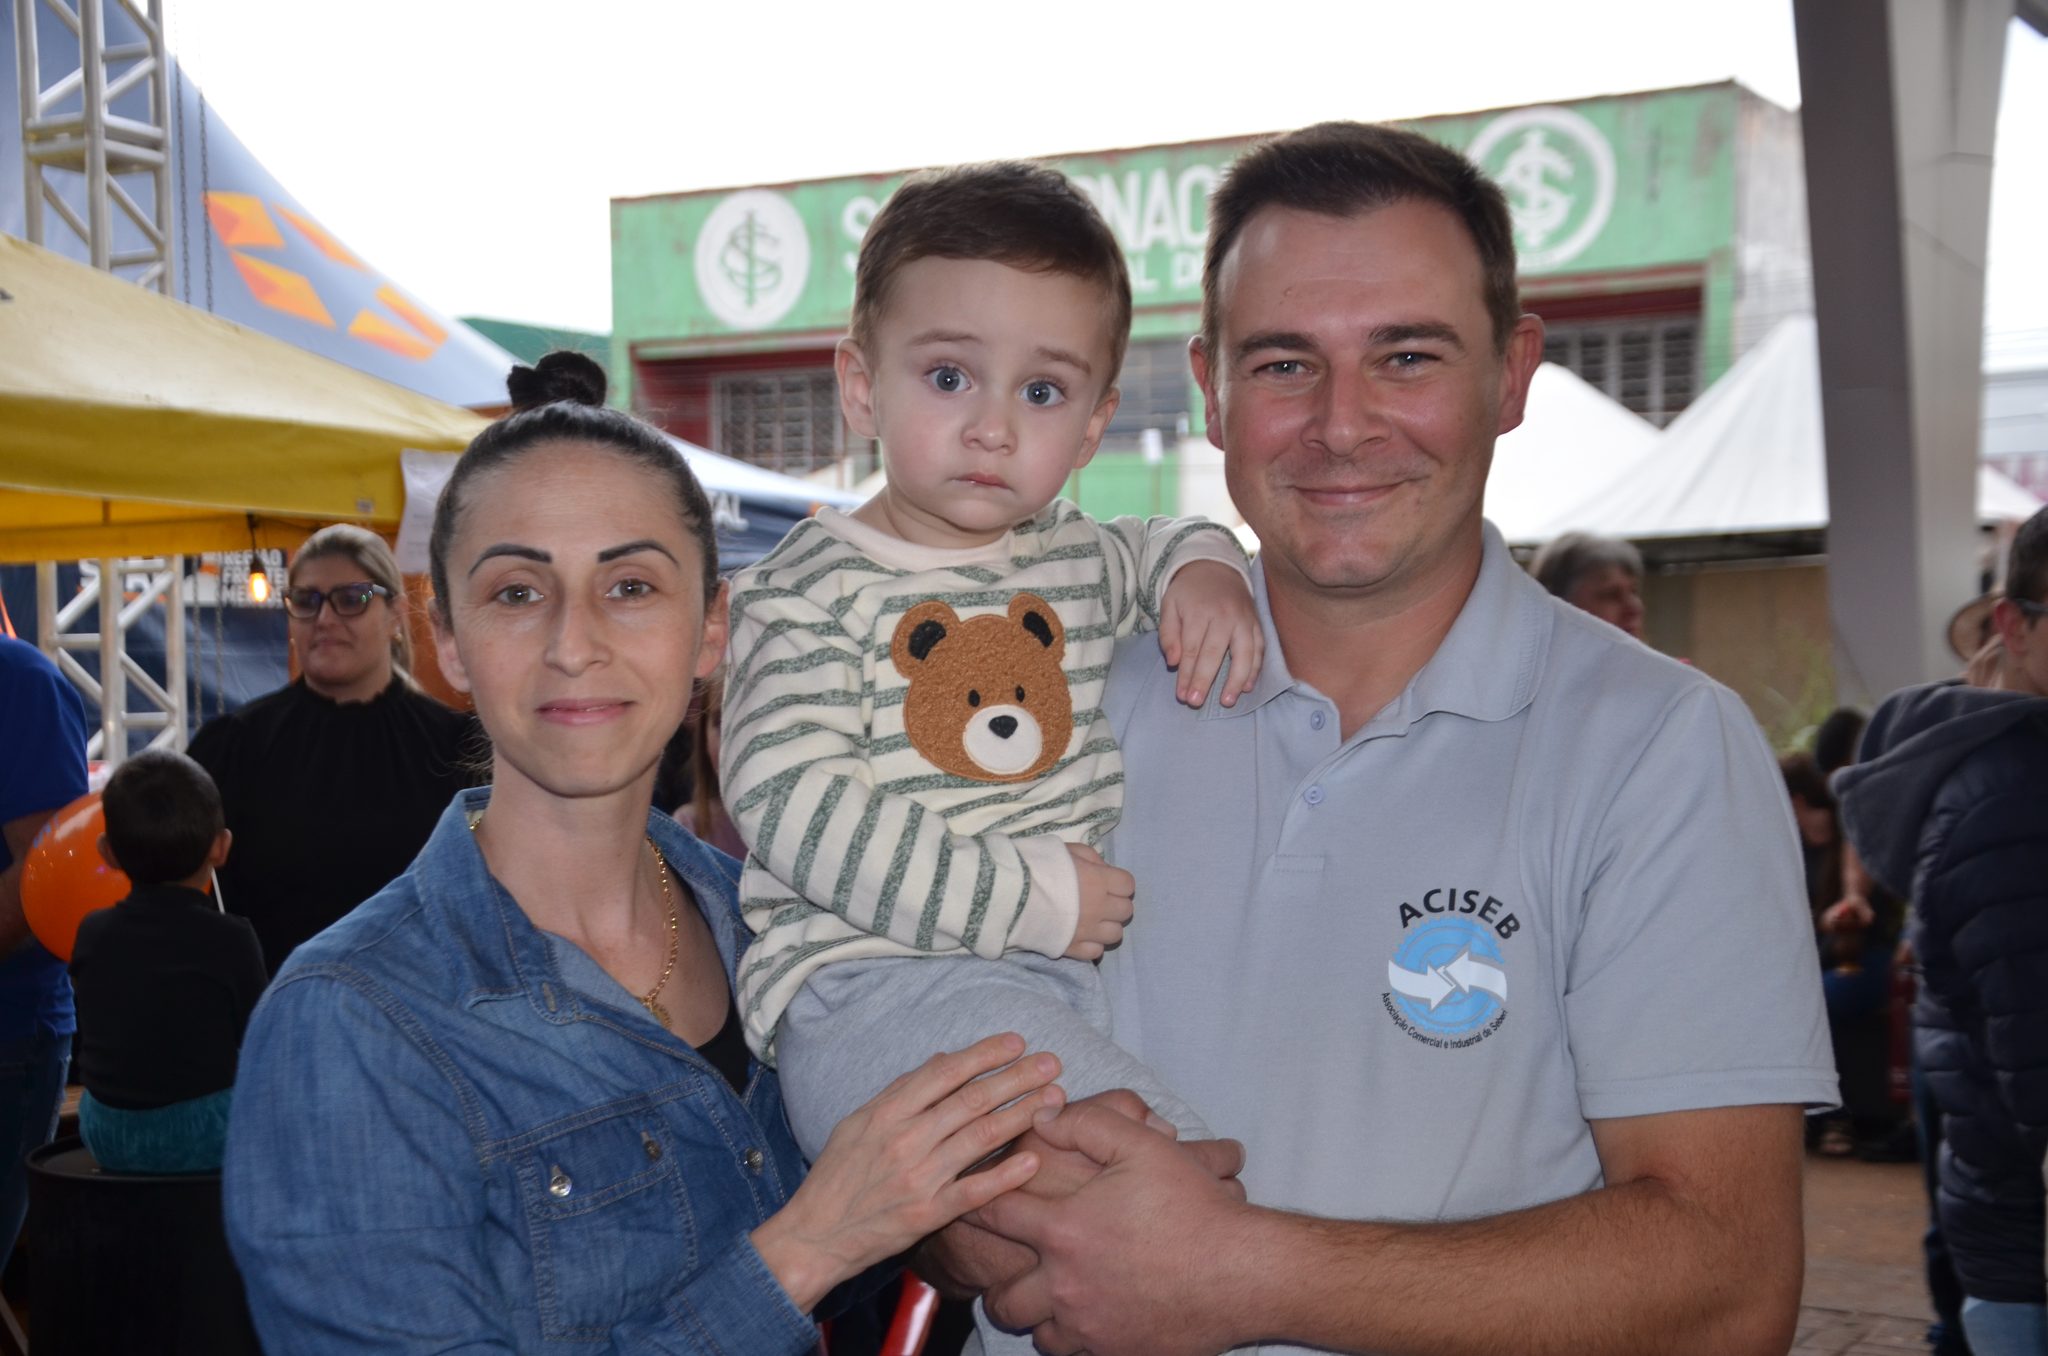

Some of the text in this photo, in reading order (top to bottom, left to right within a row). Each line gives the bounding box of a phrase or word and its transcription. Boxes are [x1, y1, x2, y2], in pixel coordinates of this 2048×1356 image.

[1399, 888, 1521, 940] ACISEB
[1382, 992, 1408, 1030] Associação
[1407, 1026, 1443, 1048] Comercial
[1444, 1041, 1449, 1049] e
[1450, 1033, 1482, 1049] Industrial
[1482, 1028, 1492, 1038] de
